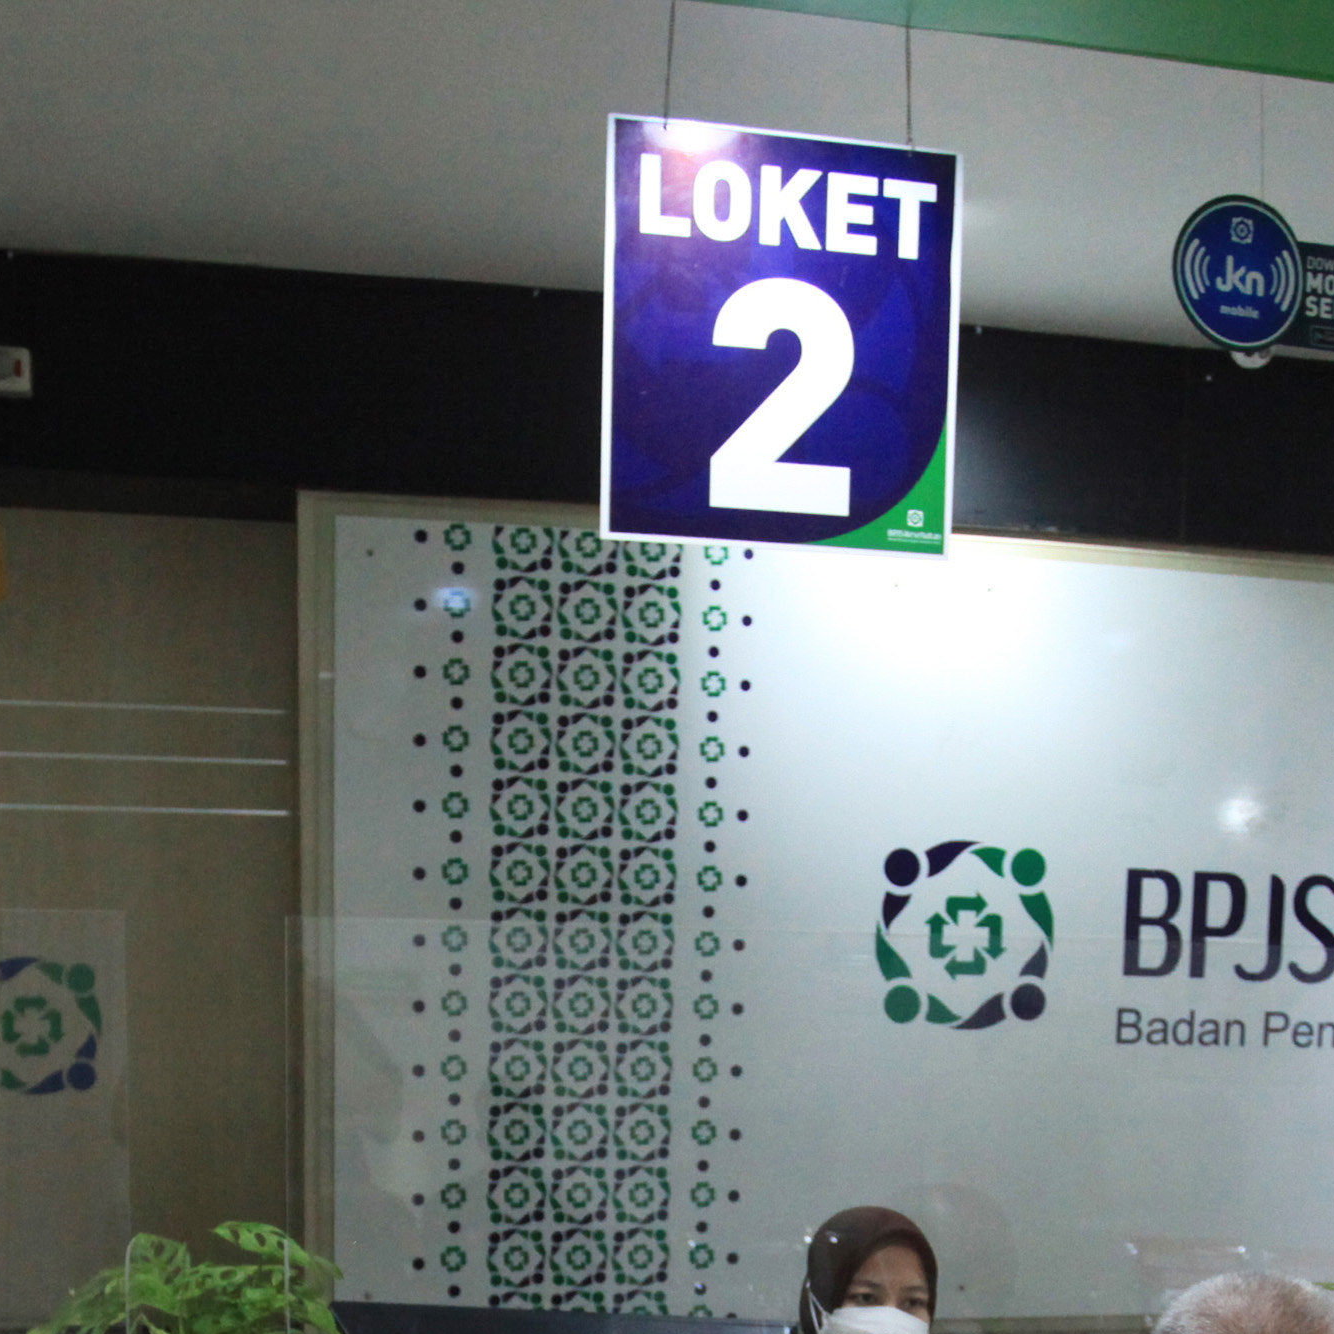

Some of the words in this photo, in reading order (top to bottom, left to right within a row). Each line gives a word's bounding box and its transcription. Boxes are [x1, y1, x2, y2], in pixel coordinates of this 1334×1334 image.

[639, 153, 938, 260] LOKET
[1219, 304, 1260, 319] mobile
[709, 277, 855, 517] 2
[1113, 1007, 1246, 1050] Badan
